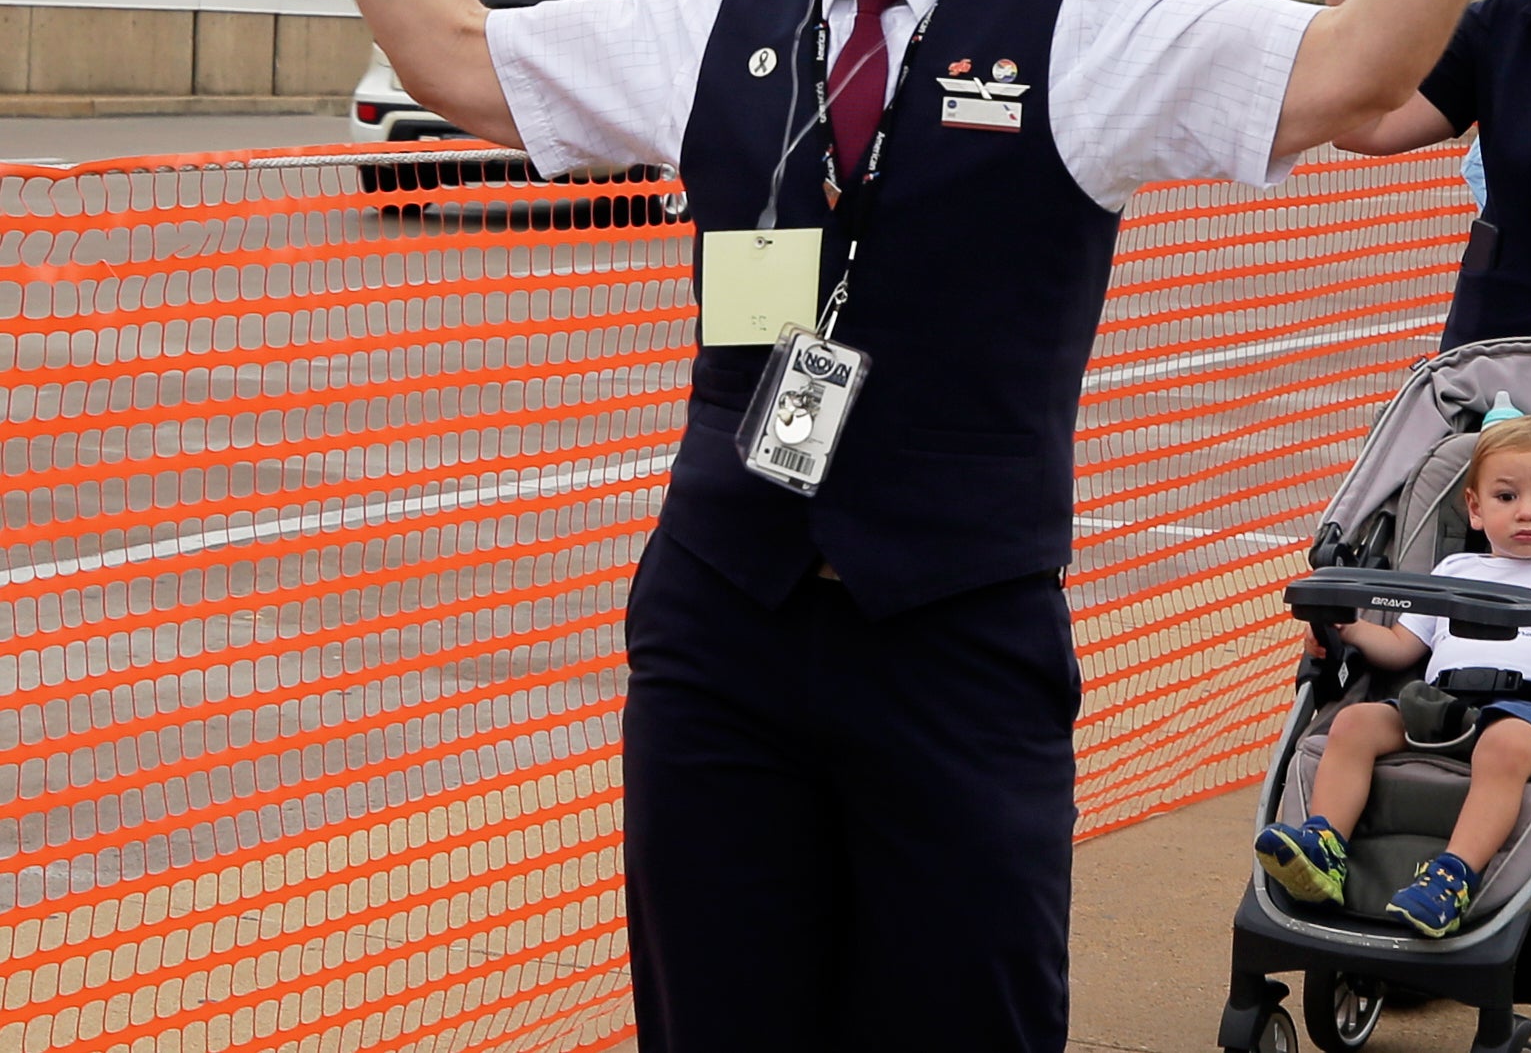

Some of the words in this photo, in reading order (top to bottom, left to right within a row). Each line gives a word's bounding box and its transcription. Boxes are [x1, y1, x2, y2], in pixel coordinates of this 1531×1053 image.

[816, 29, 826, 61] American
[868, 131, 886, 171] American
[1371, 596, 1412, 608] BRAVO
